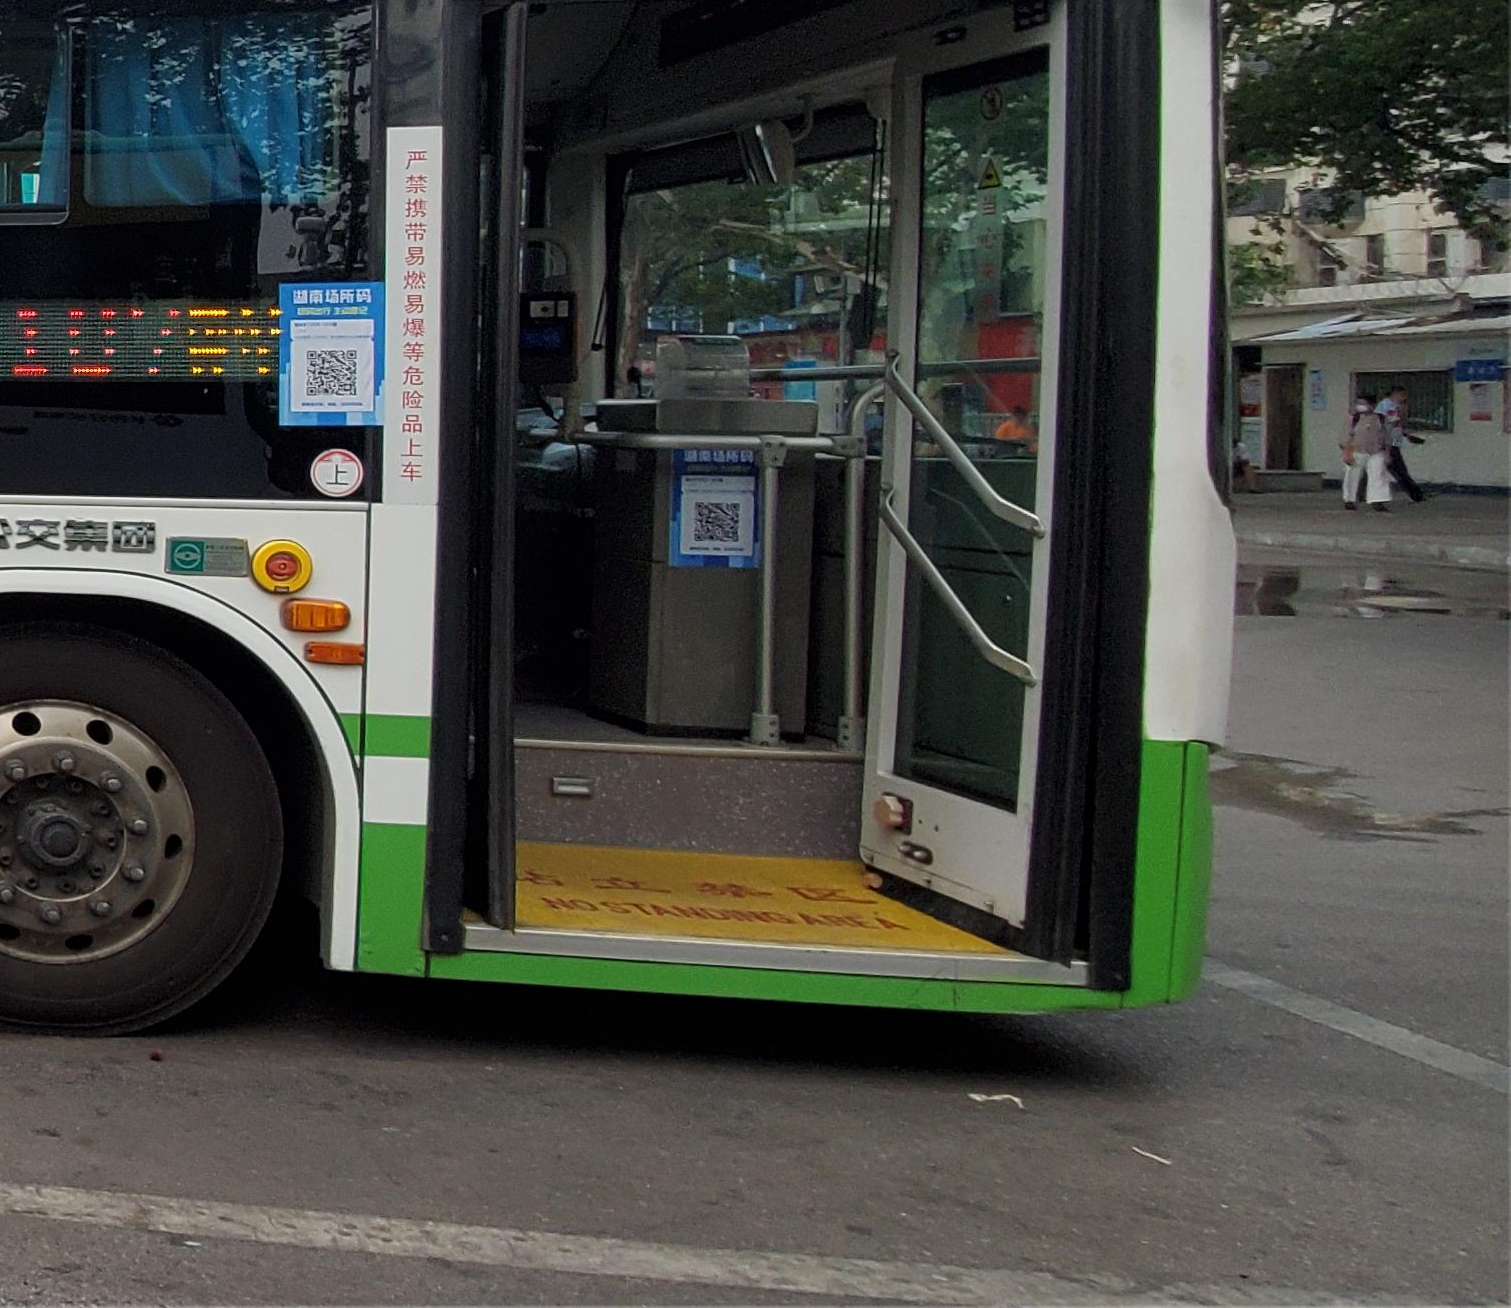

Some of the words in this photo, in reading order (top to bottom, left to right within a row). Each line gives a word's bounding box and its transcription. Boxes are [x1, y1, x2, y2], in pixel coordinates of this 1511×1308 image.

[400, 150, 428, 482] 严禁携带易燃易爆等危险品上车
[326, 463, 349, 486] 上
